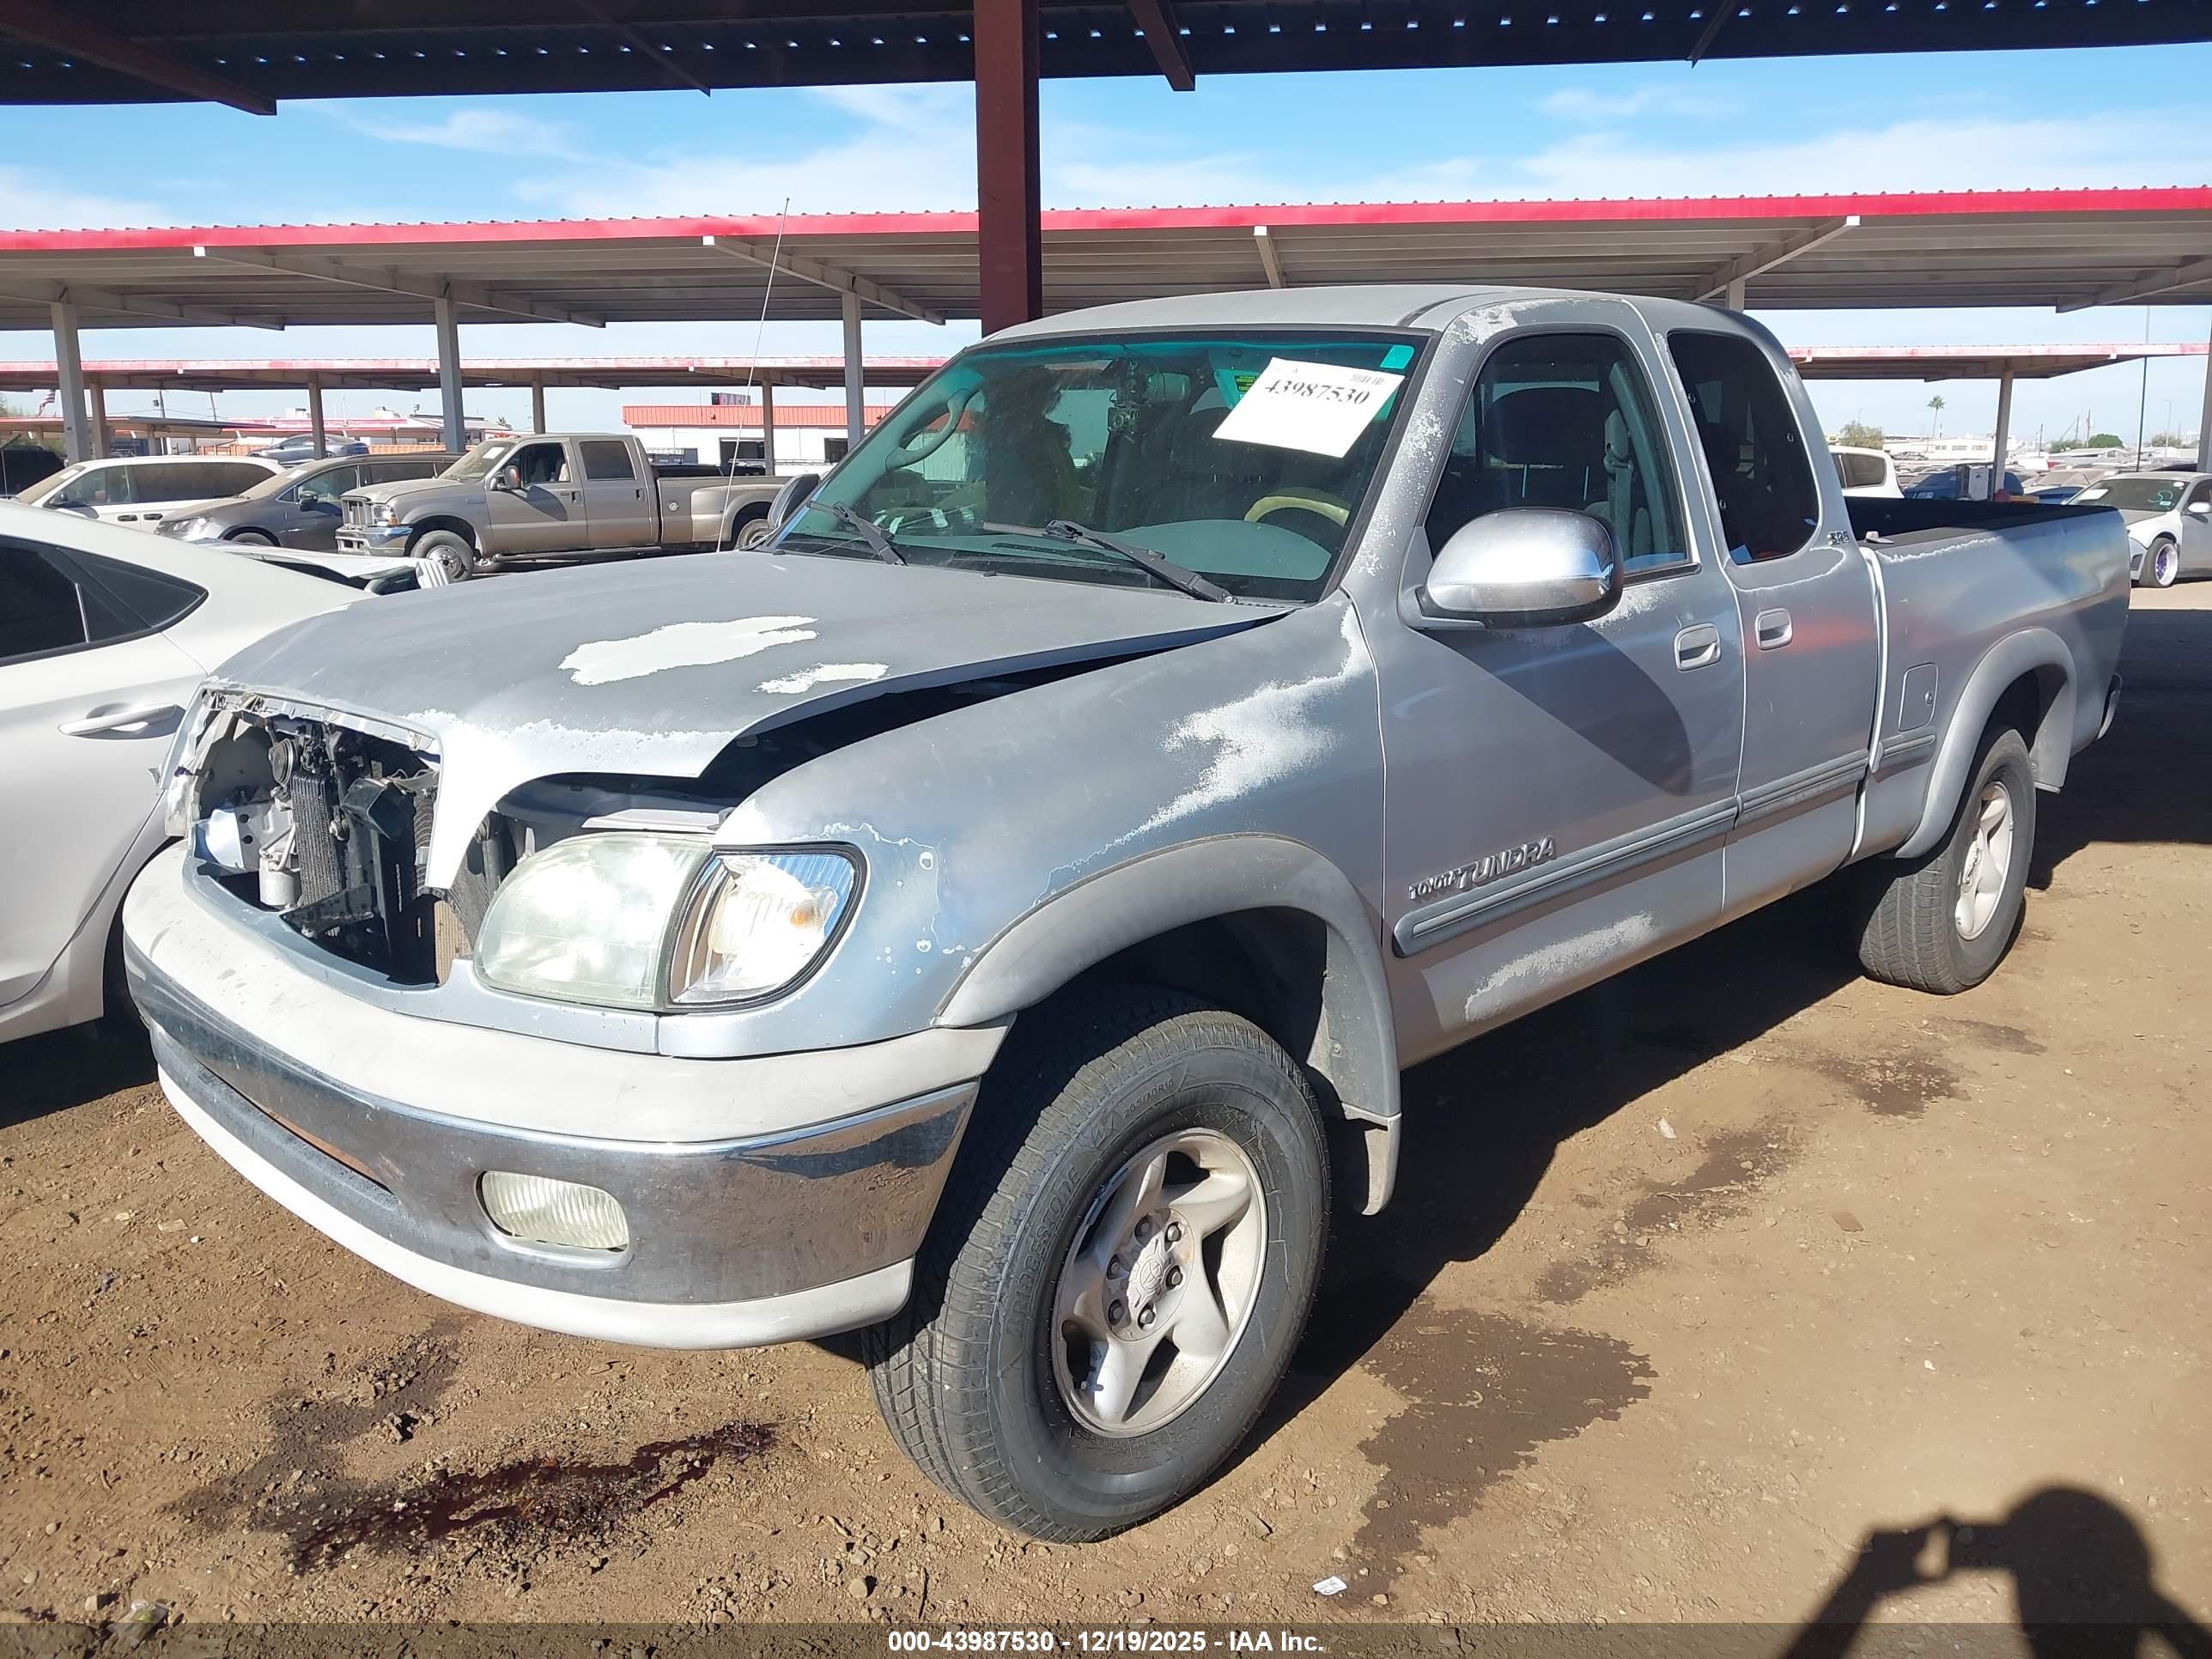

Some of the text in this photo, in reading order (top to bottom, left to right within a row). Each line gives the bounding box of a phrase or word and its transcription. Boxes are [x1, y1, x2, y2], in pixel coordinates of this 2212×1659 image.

[1265, 379, 1370, 405] 43987530
[1408, 834, 1554, 901] TOYOTA TUNDRA
